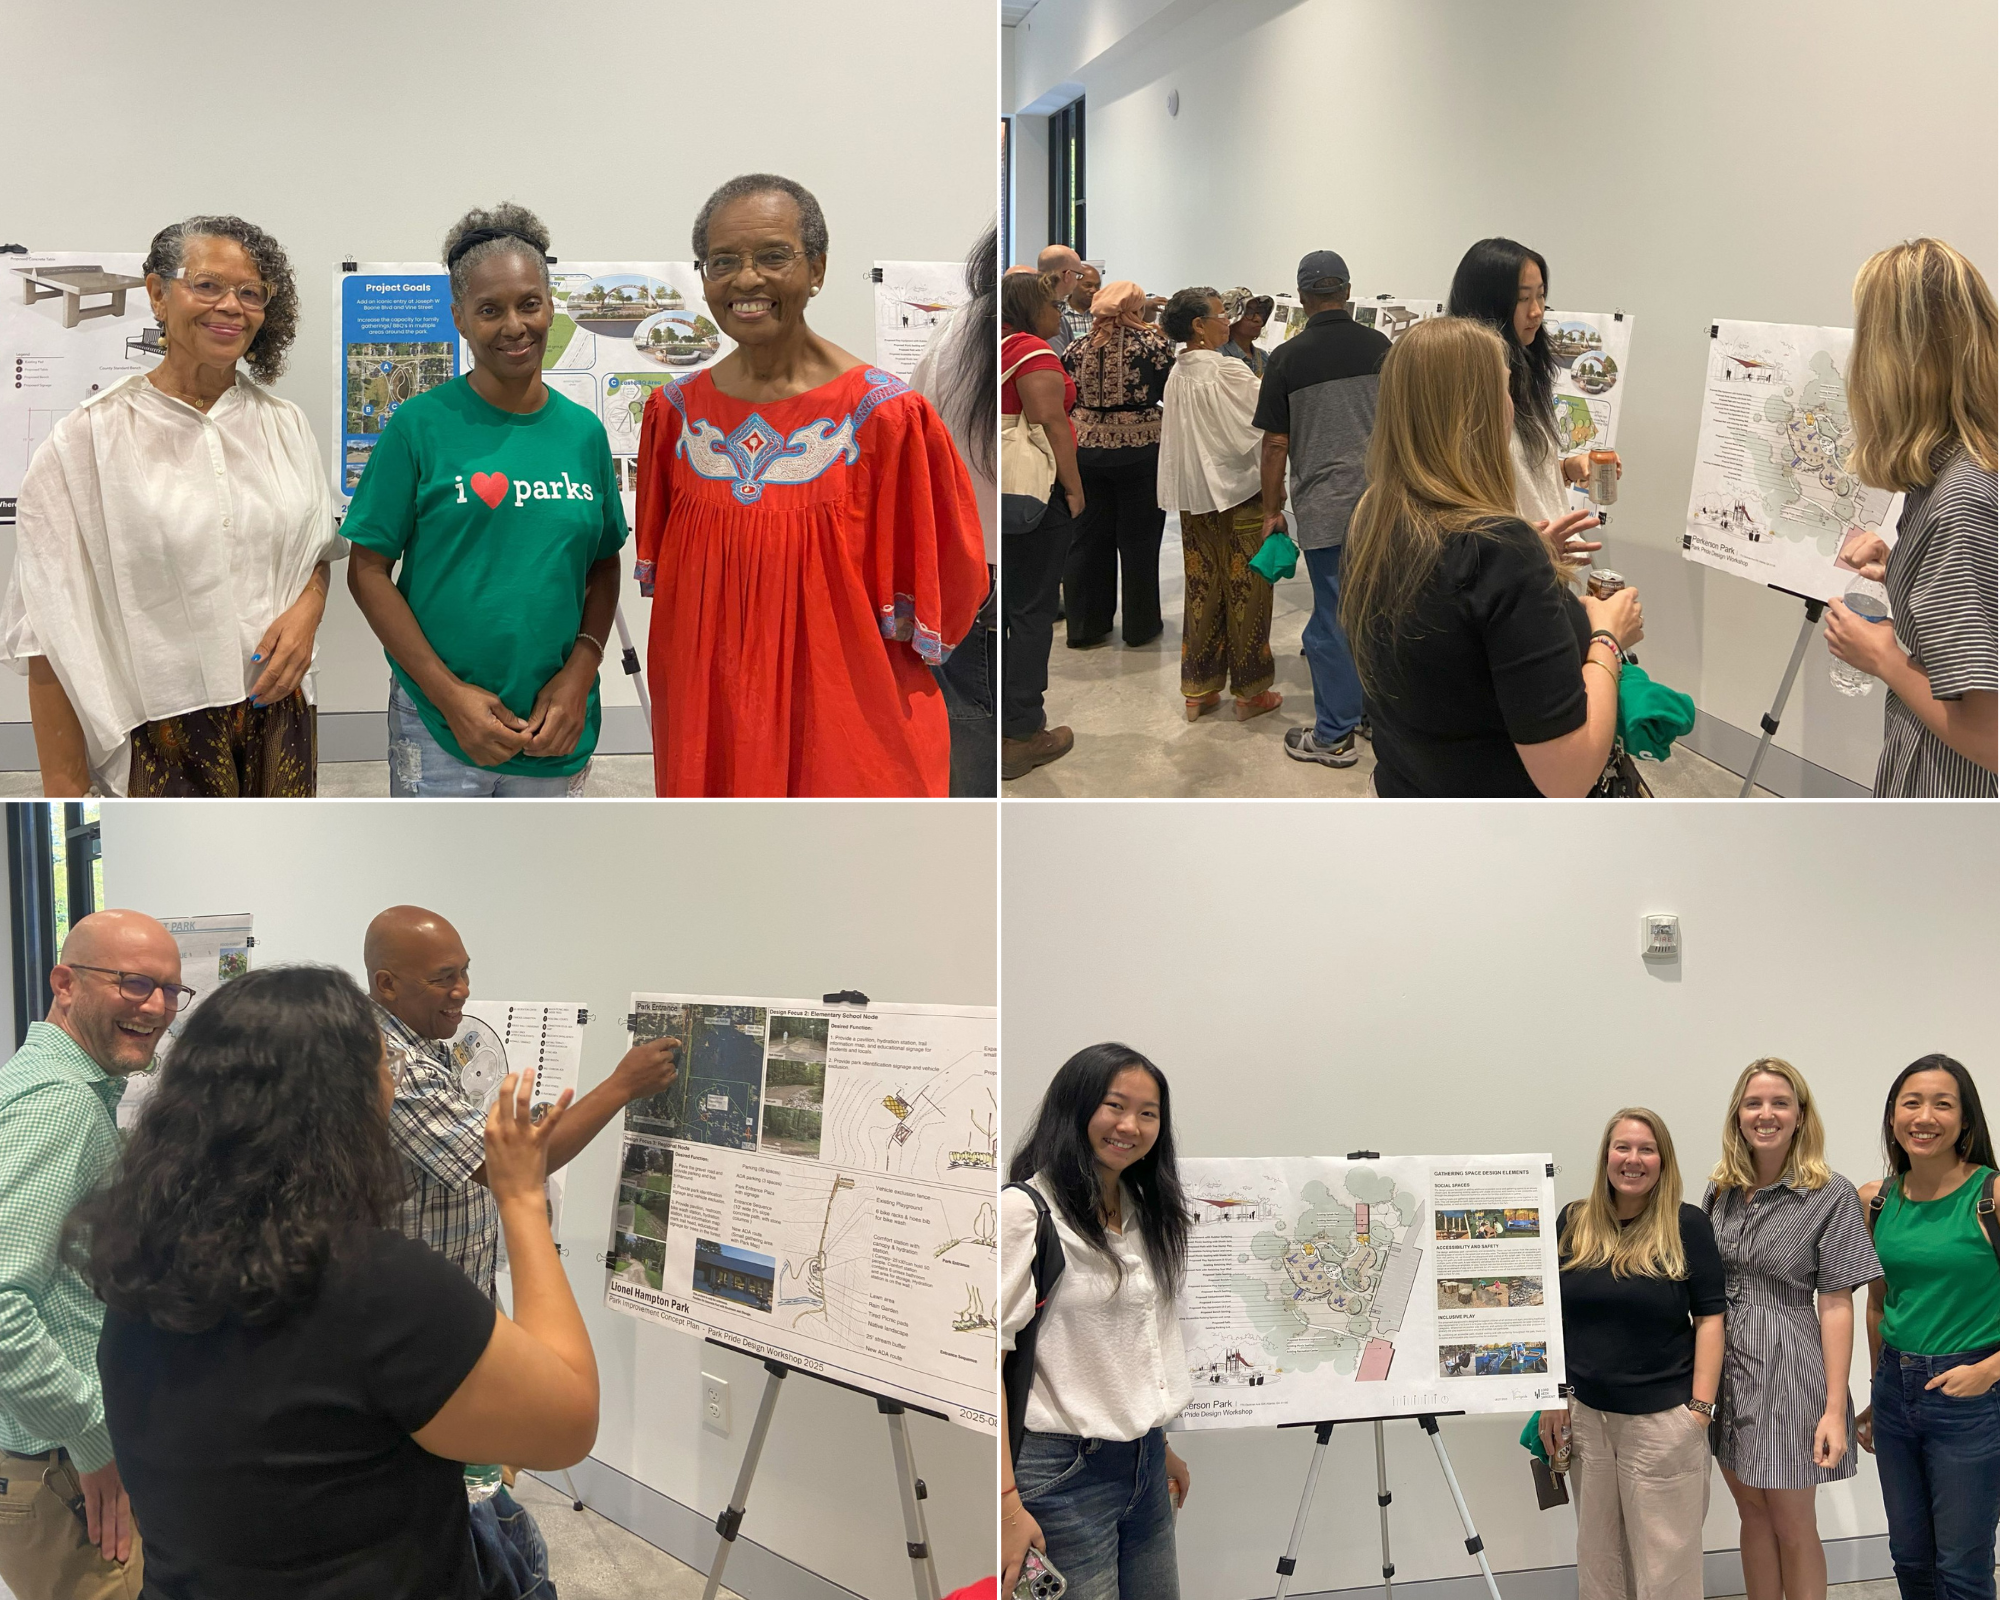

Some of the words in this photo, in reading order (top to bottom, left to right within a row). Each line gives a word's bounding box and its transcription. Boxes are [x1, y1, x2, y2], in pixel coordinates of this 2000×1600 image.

[366, 283, 401, 294] Project
[403, 284, 431, 292] Goals
[455, 476, 467, 504] i
[514, 472, 594, 507] parks
[1693, 535, 1718, 549] Perkerson
[1720, 544, 1735, 554] Park
[1701, 547, 1711, 555] Pride
[1711, 550, 1725, 559] Design
[1727, 555, 1748, 567] Workshop
[171, 922, 195, 931] PARK
[652, 1004, 677, 1012] Entrance
[811, 1011, 840, 1019] Elementary
[876, 1185, 893, 1193] Vehicle
[894, 1189, 916, 1197] exclusion
[876, 1198, 895, 1206] Existing
[896, 1201, 923, 1211] Playground
[873, 1234, 892, 1243] Comfort
[894, 1238, 908, 1247] station
[873, 1242, 890, 1250] canopy
[896, 1246, 918, 1255] hydration
[611, 1281, 633, 1295] Lionel
[635, 1287, 669, 1306] Hampton
[671, 1300, 689, 1313] Park
[870, 1293, 882, 1301] Lawn
[881, 1305, 899, 1314] Garden
[882, 1315, 896, 1323] Picnic
[897, 1319, 908, 1328] pads
[609, 1296, 621, 1305] Park
[623, 1300, 660, 1318] Improvement
[661, 1311, 685, 1326] Concept
[686, 1319, 700, 1330] Plan
[708, 1327, 722, 1338] Park
[724, 1333, 741, 1344] Pride
[743, 1339, 765, 1353] Design
[767, 1347, 802, 1365] Workshop
[804, 1359, 824, 1371] 2025
[868, 1321, 883, 1330] Native
[885, 1325, 908, 1337] landscape
[875, 1337, 891, 1345] stream
[892, 1341, 906, 1349] buffer
[878, 1349, 889, 1357] ADA
[890, 1353, 902, 1361] route
[1213, 1400, 1232, 1408] Park
